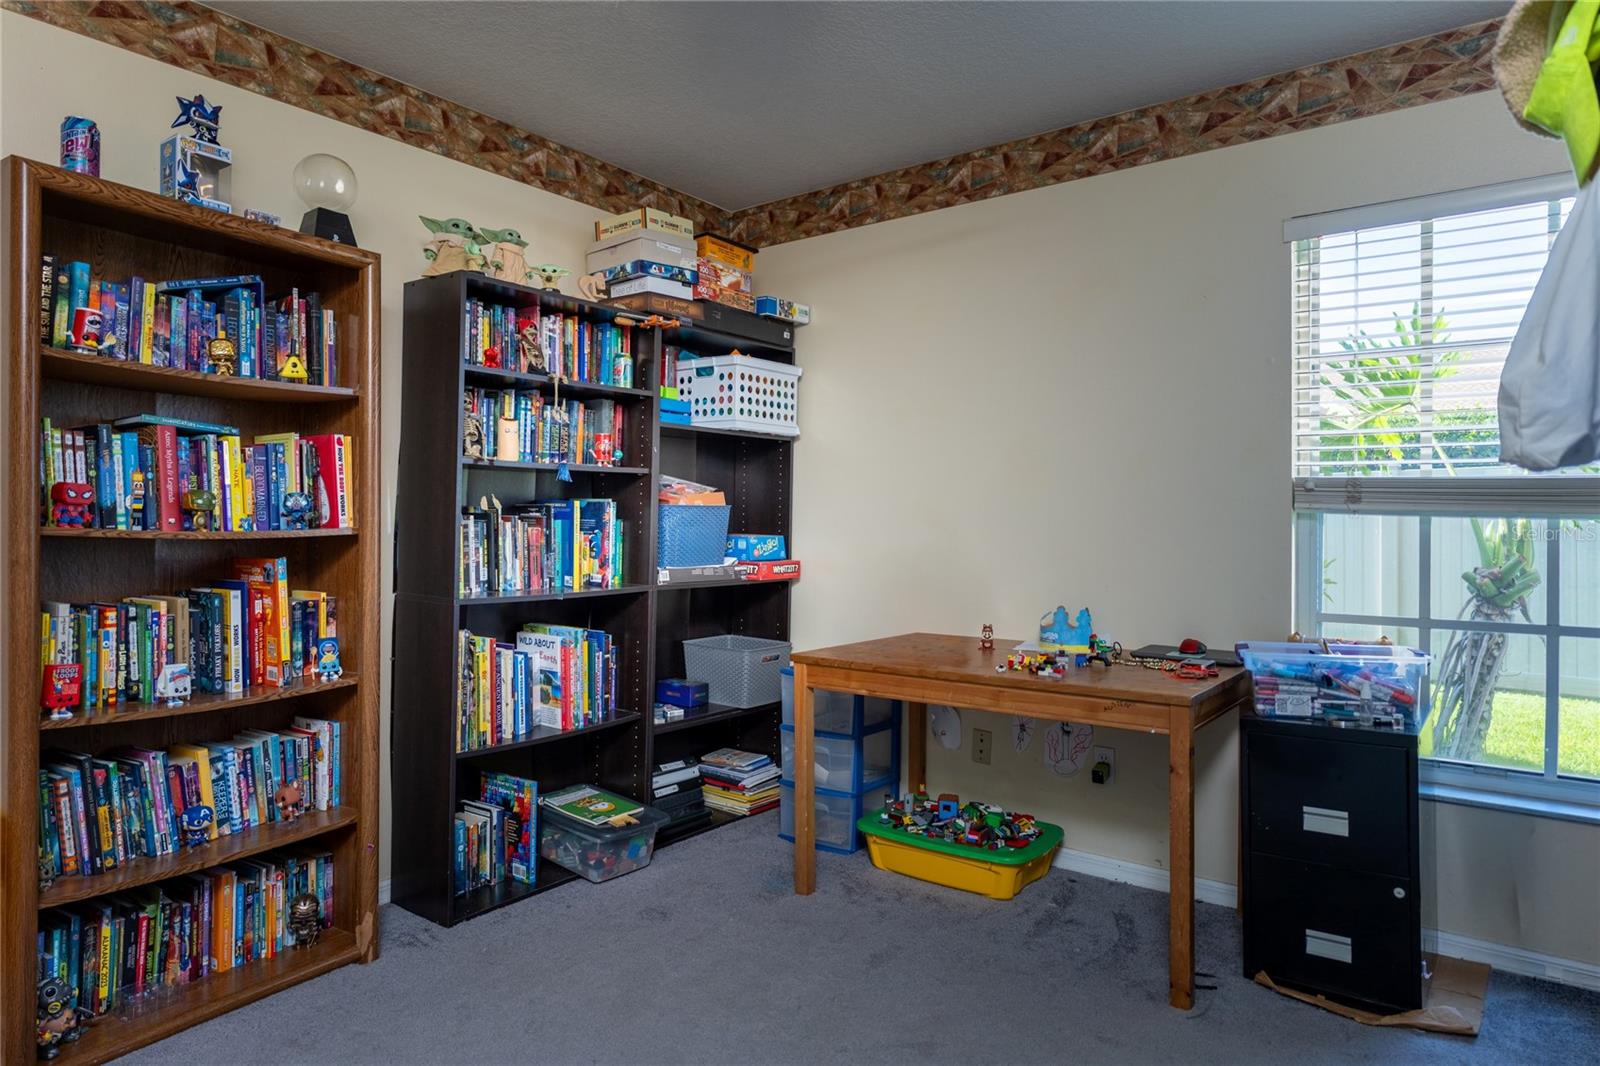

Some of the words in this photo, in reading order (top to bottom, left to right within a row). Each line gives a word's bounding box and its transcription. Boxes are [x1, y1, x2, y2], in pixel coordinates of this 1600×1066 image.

[43, 265, 54, 284] STAR
[42, 284, 52, 297] THE
[41, 311, 51, 325] SUN
[41, 326, 50, 339] THE
[164, 430, 173, 448] Aztec
[166, 448, 175, 469] Myths
[168, 476, 177, 503] Legends
[214, 623, 222, 652] FOLKLORE
[519, 636, 533, 646] WILD
[533, 638, 556, 649] ABOUT
[119, 650, 127, 666] LION
[539, 650, 558, 664] Earth
[214, 655, 222, 678] FREAKY
[55, 672, 79, 680] LOOPS
[218, 780, 228, 811] KEEPER
[102, 935, 110, 970] ALMANAC
[101, 971, 109, 988] 2023
